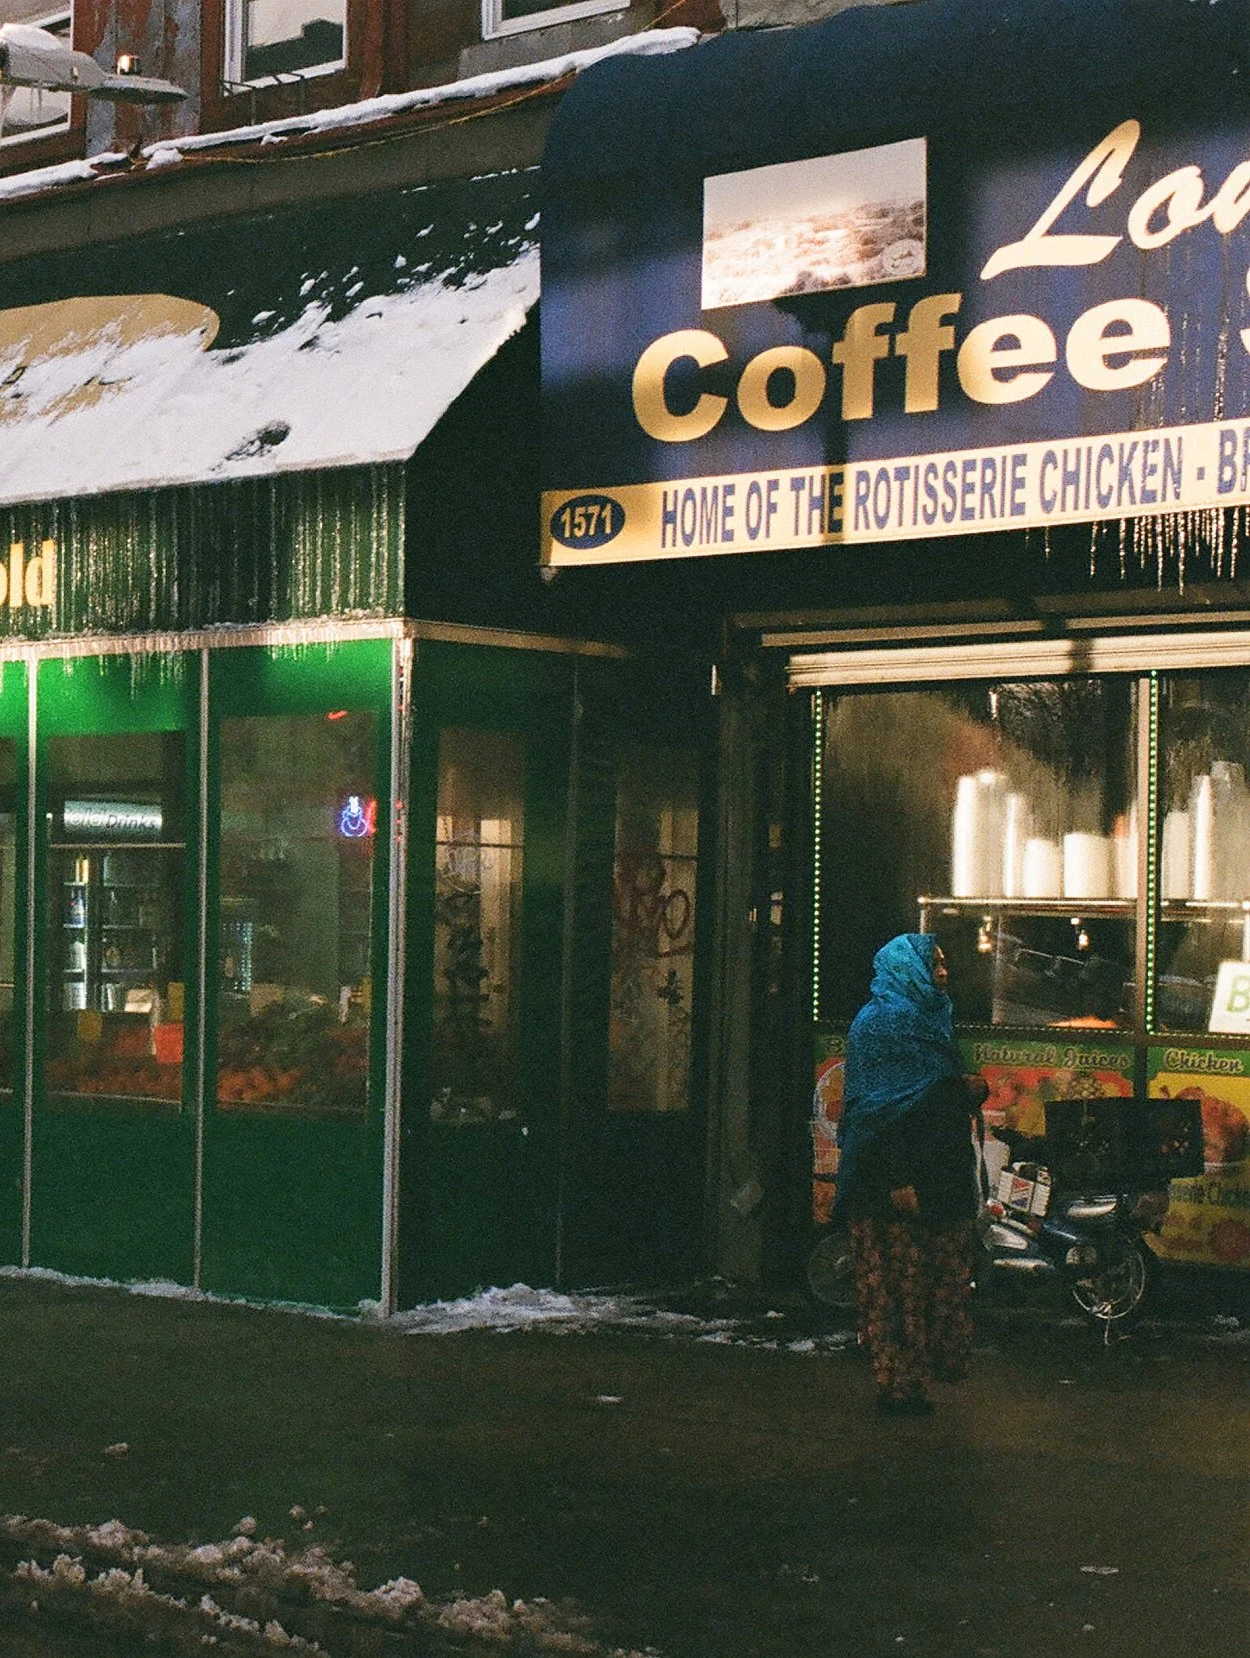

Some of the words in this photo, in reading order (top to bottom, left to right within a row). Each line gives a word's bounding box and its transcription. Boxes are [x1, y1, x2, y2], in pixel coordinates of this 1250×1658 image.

[631, 292, 1171, 444] Coffee
[660, 483, 736, 549] HOME
[745, 478, 780, 542] OF
[789, 471, 845, 537] THE
[853, 453, 1028, 531] ROTISSERIE
[1039, 436, 1184, 515] CHICKEN
[559, 502, 613, 540] 1571
[106, 812, 158, 830] Drinks
[974, 1042, 1057, 1063] Natural
[1063, 1045, 1131, 1069] Juices
[1164, 1047, 1244, 1074] Chicken
